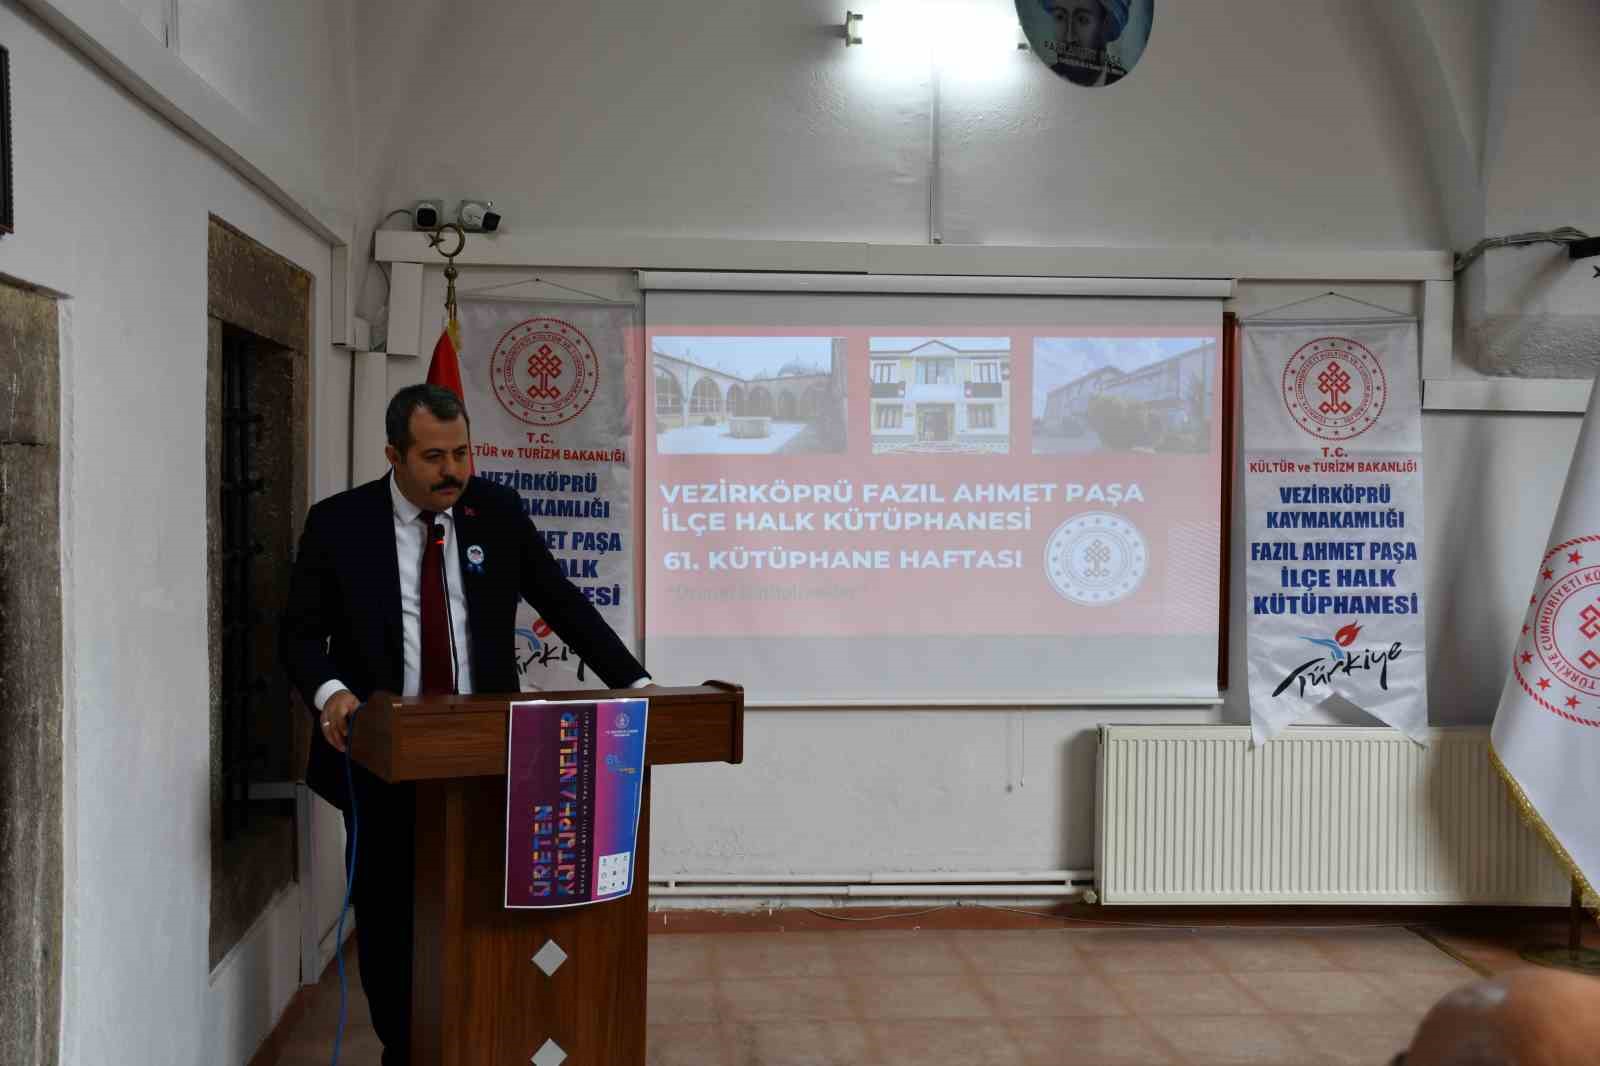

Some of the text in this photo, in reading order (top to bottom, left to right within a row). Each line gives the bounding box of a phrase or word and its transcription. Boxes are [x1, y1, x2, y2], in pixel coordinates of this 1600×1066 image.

[526, 432, 554, 444] T.C.
[502, 448, 514, 458] ve
[517, 446, 560, 460] TURİZM
[563, 448, 625, 463] BAKANLIĞI
[1320, 447, 1348, 458] T.C.
[1249, 459, 1417, 473] KÜLTÜR ve TURİZM BAKANLIĞI
[660, 478, 1144, 507] VEZİRKÖPRÜ FAZIL AHMET PAŞA
[1280, 484, 1391, 504] VEZİRKÖPRÜ
[519, 497, 610, 519] AKAMLIĞI
[1267, 508, 1405, 529] KAYMAKAMLIĞI
[661, 507, 1031, 536] İLÇE HALK KÜTÜPHANESİ
[571, 532, 621, 554] PAŞA
[1251, 542, 1417, 564] FAZIL AHMET PAŞA
[559, 559, 599, 577] ALK
[663, 546, 1023, 570] 61. KÜTÜPHANE HAFTASI
[1280, 566, 1396, 591] İLÇE HALK
[1253, 593, 1418, 615] KÜTÜPHANESİ
[1271, 641, 1403, 699] Türkiye
[529, 805, 553, 897] ÜRETEN
